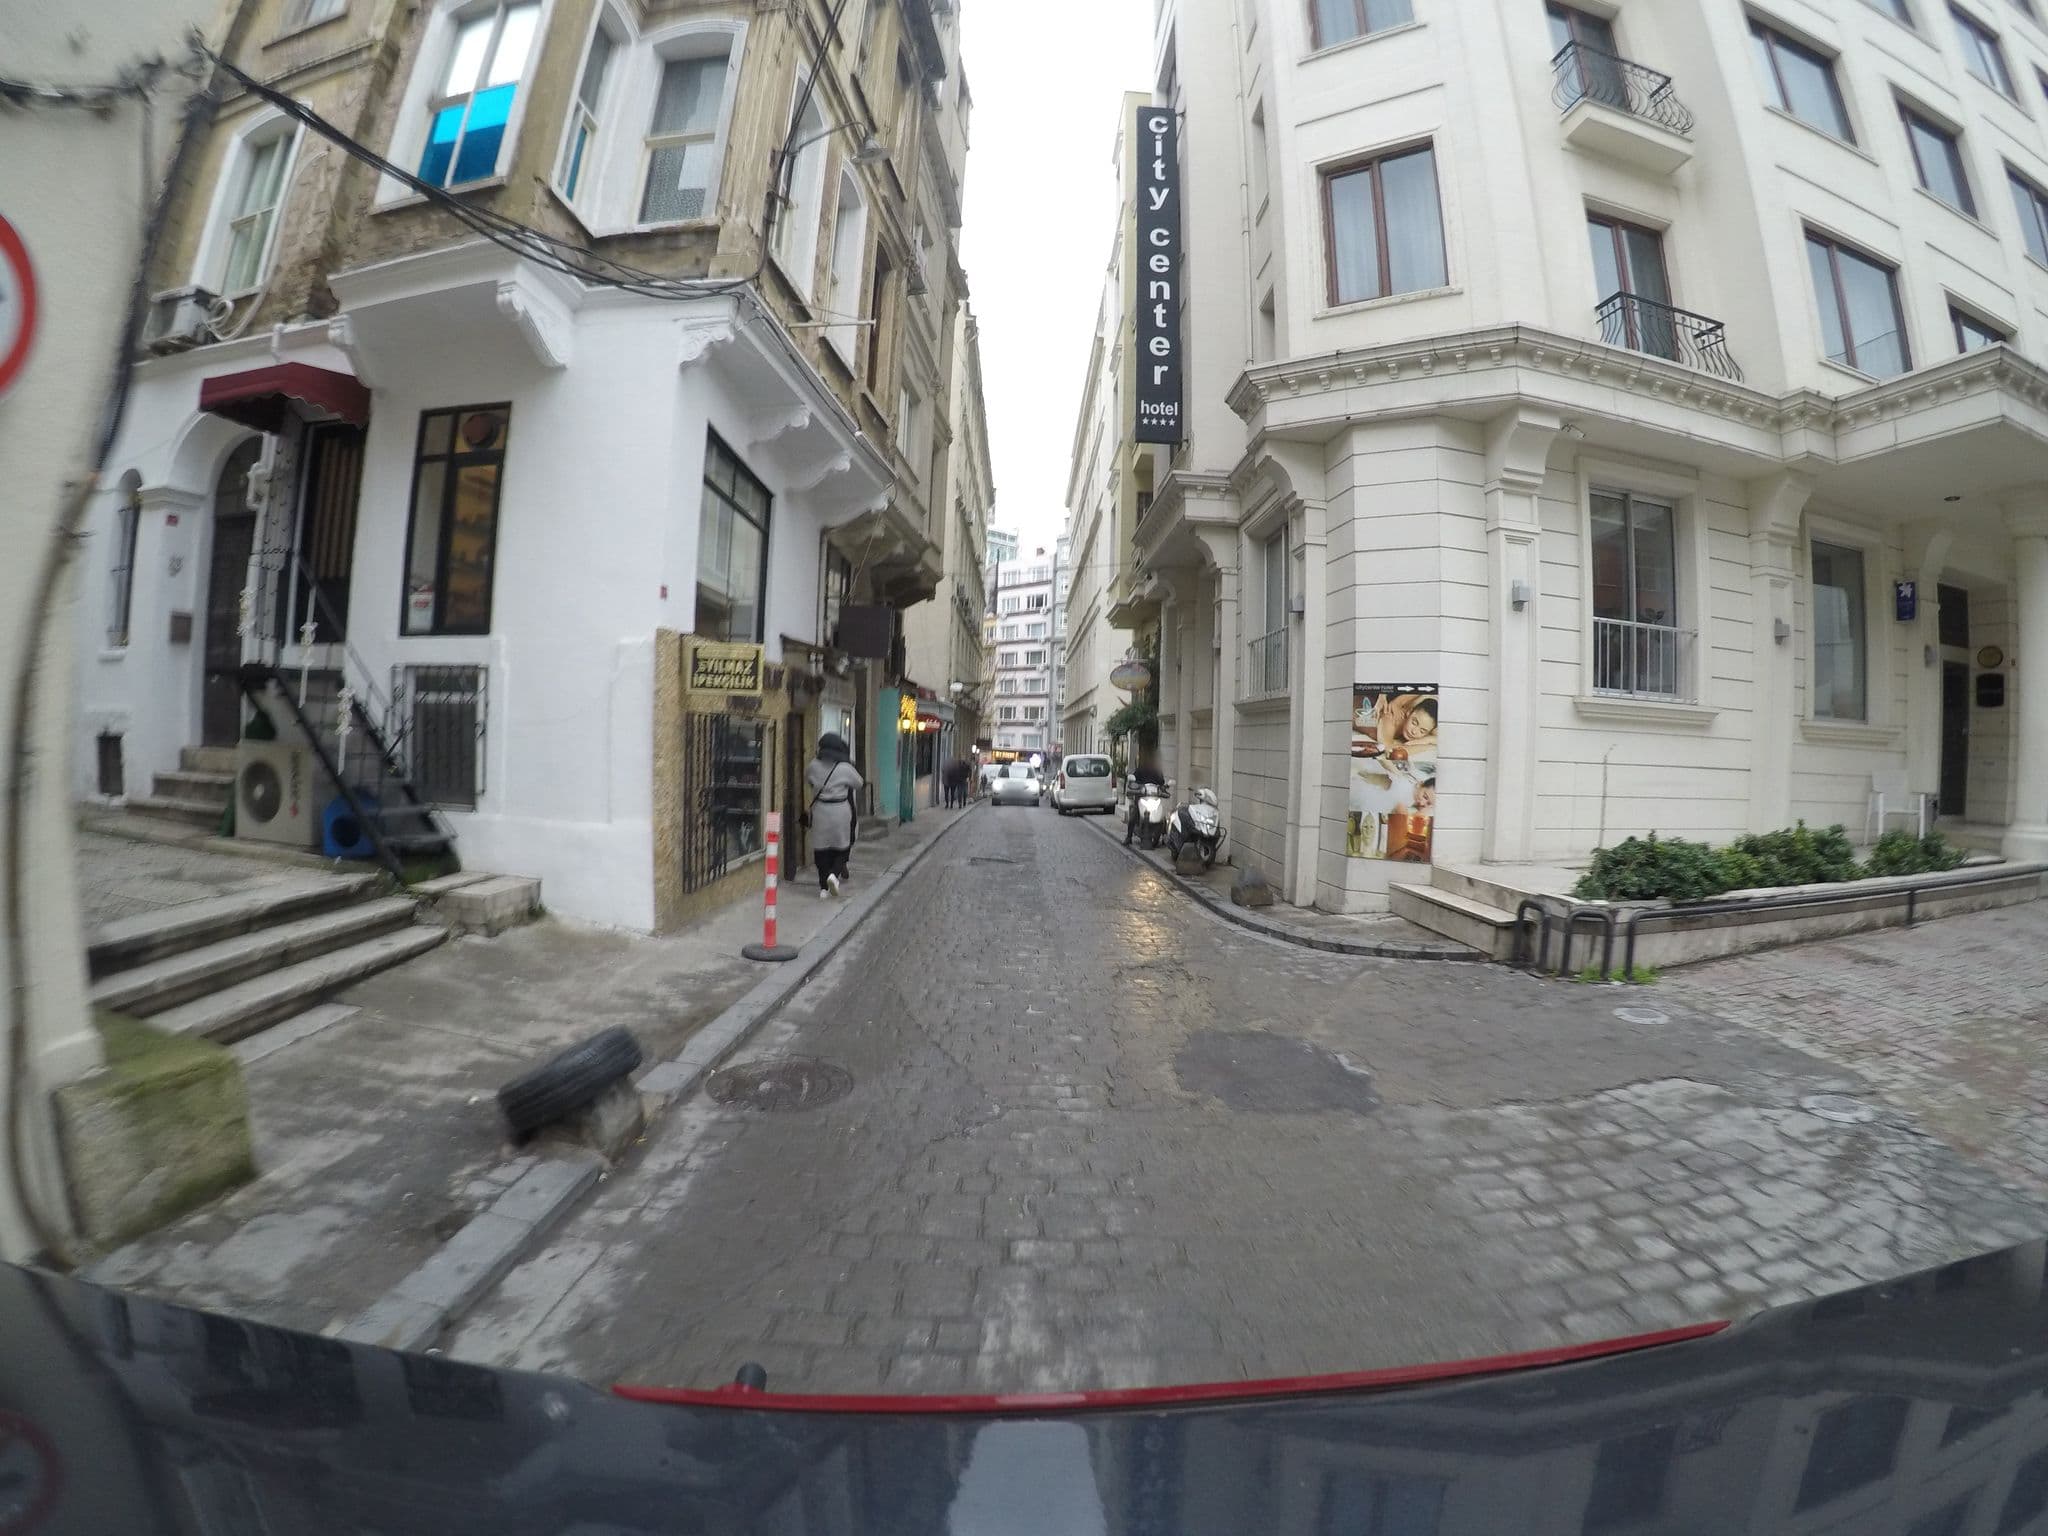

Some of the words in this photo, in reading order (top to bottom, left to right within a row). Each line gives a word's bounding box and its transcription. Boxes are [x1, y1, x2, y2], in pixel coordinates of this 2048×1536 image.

[1149, 116, 1169, 210] city
[1150, 228, 1170, 385] center
[1140, 401, 1178, 416] hotel
